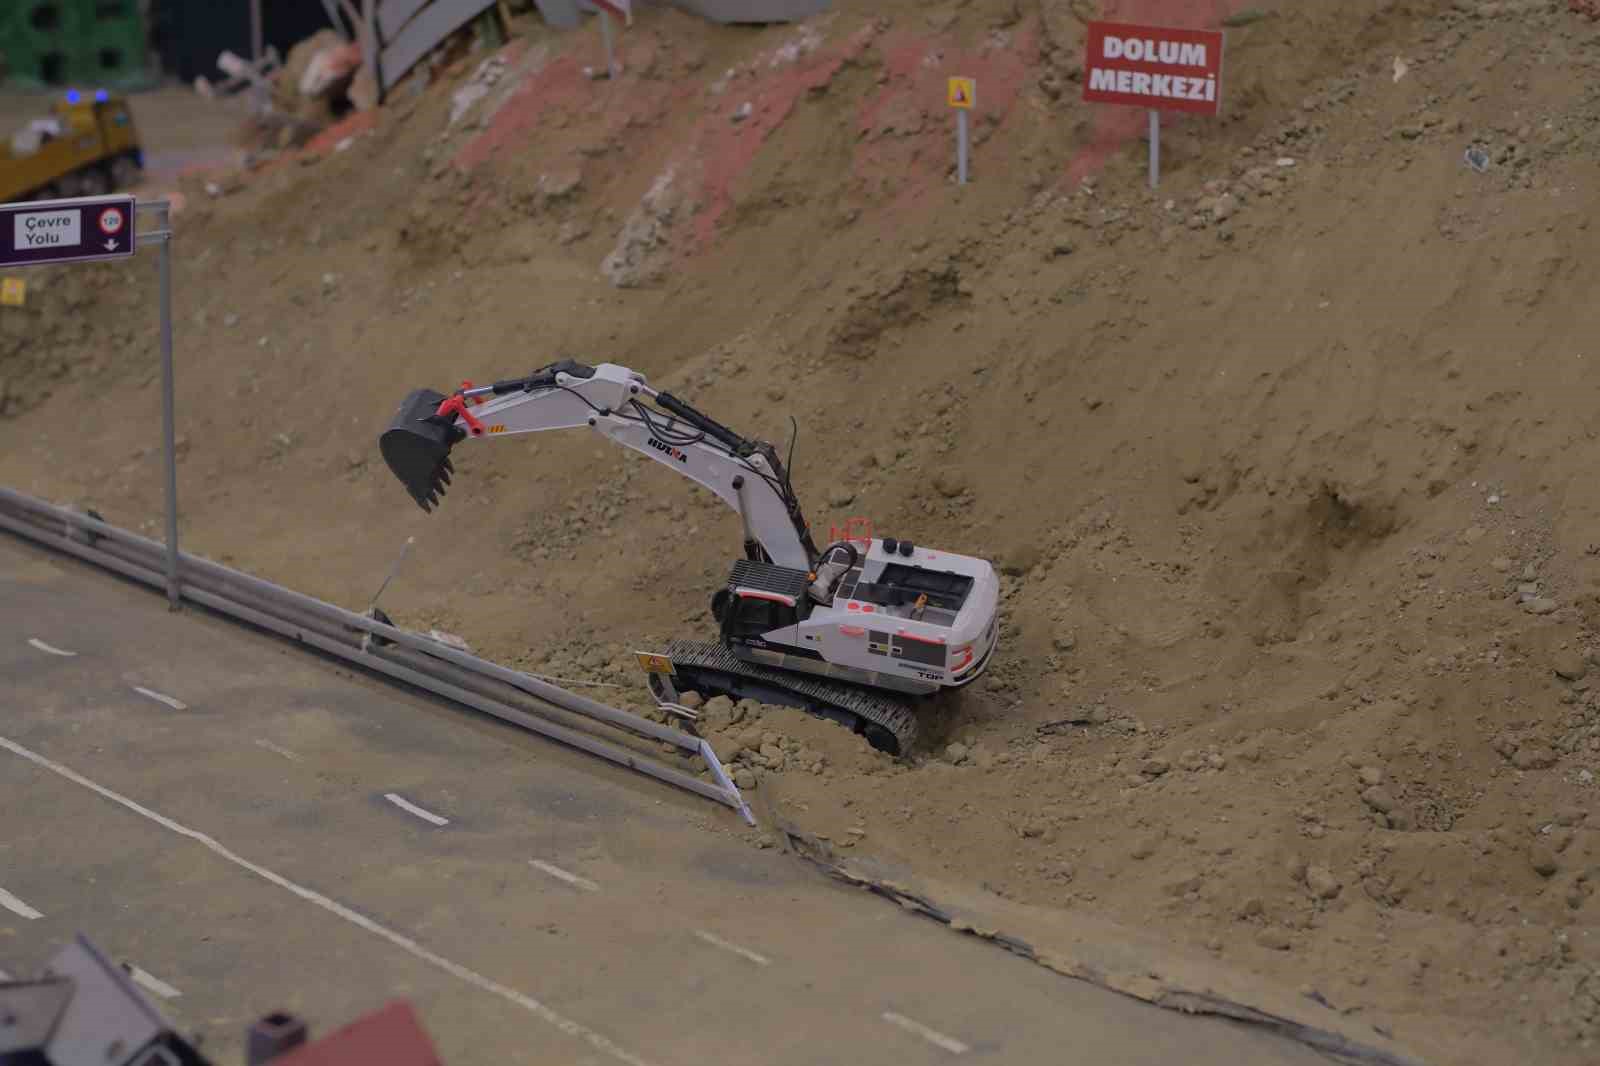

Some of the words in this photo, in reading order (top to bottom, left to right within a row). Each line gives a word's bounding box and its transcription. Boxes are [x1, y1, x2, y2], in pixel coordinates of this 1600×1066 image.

[1103, 35, 1207, 67] DOLUM
[1088, 67, 1216, 102] MERKEZİ
[25, 216, 71, 231] Çevre
[26, 232, 60, 246] Yolu
